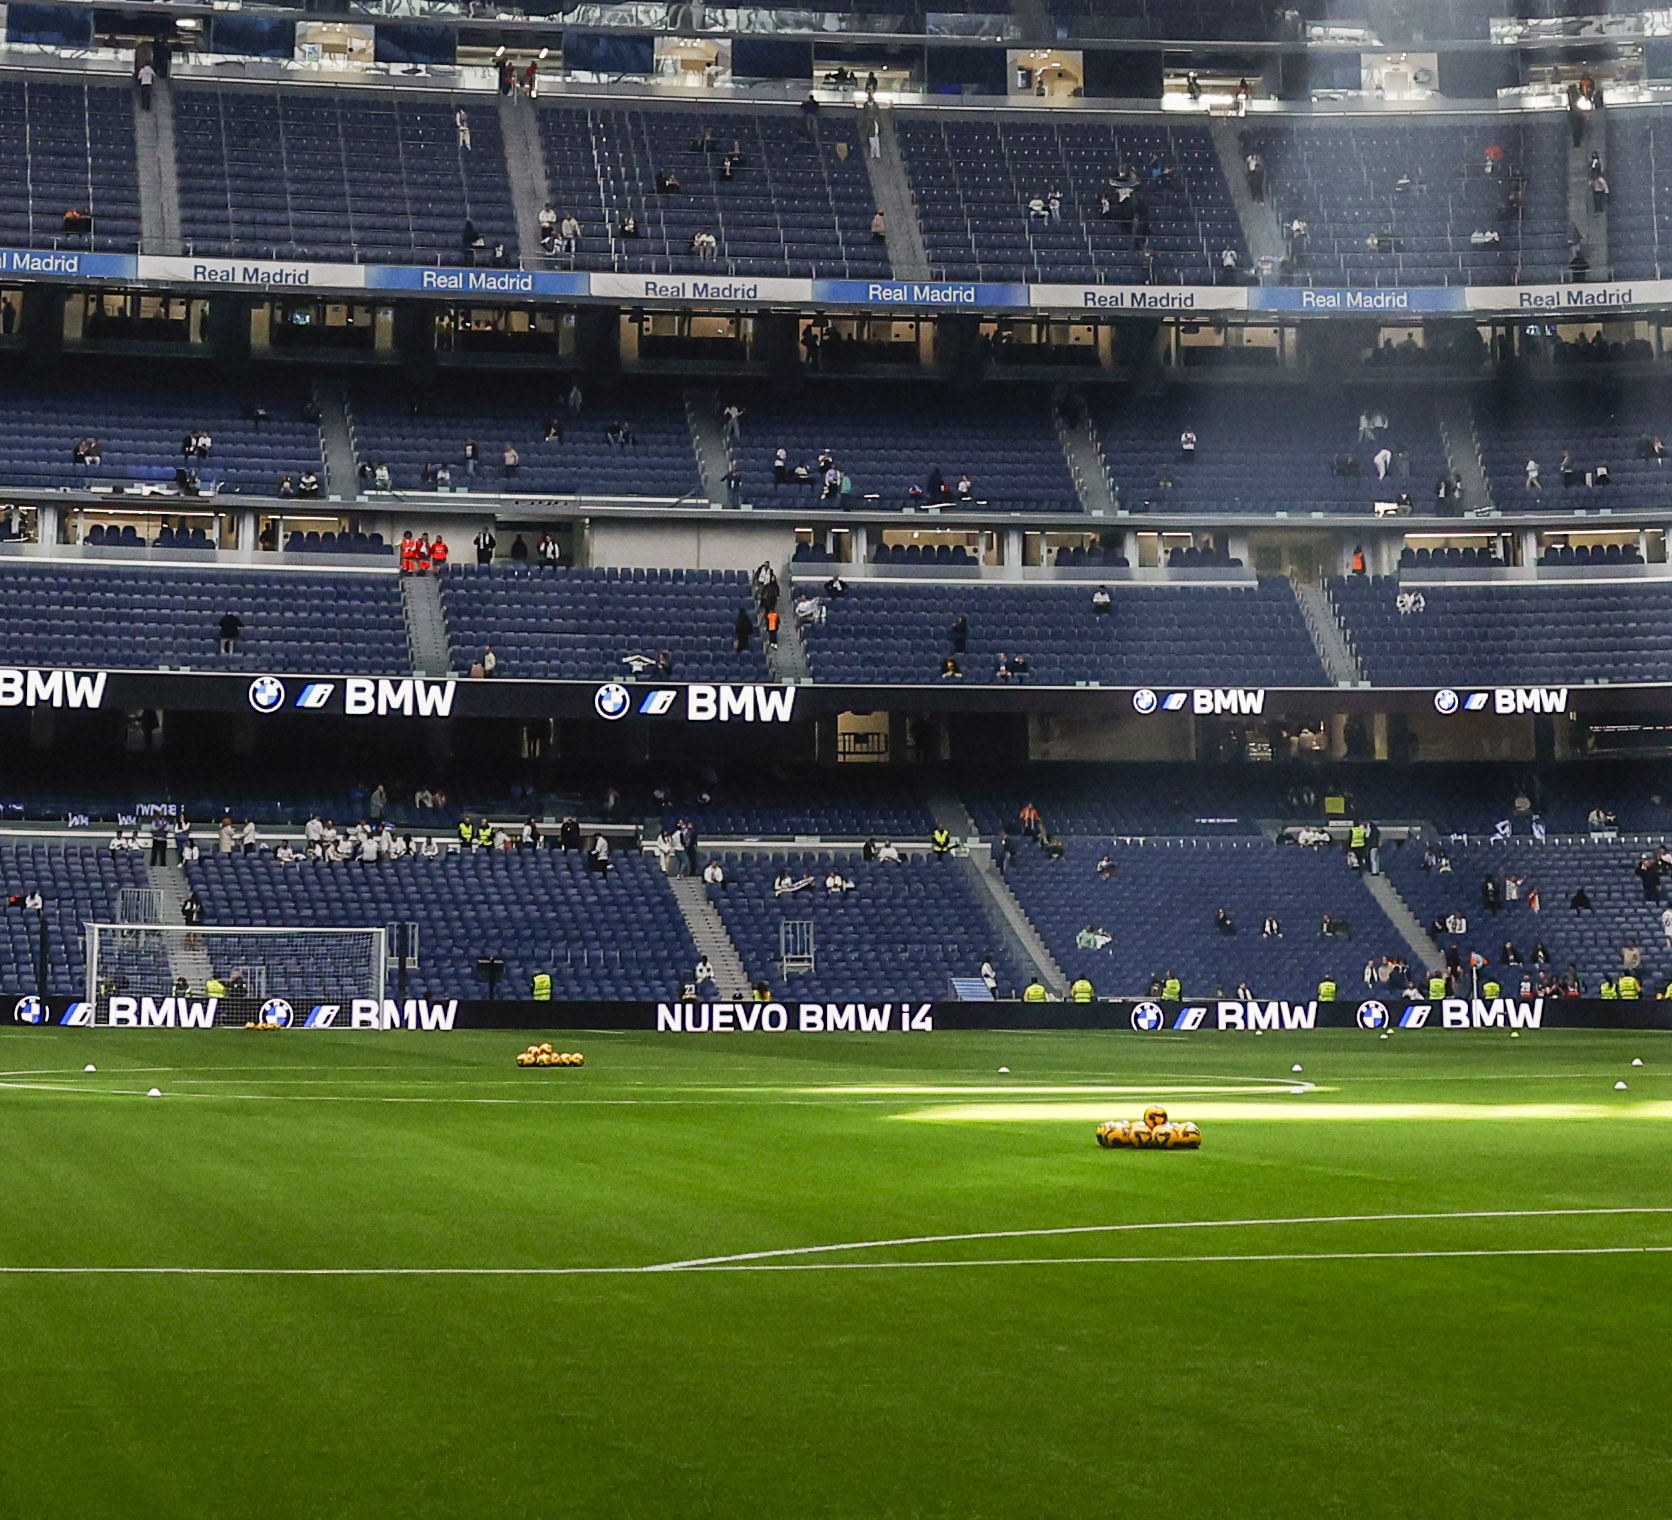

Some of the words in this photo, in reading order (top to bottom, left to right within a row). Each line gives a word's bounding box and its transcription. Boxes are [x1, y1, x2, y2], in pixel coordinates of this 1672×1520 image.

[12, 253, 78, 273] Madrid
[193, 264, 238, 284] Real
[242, 266, 309, 286] Madrid
[422, 270, 466, 289] Real
[471, 272, 532, 292] Madrid
[644, 281, 686, 299] Real
[692, 282, 758, 300] Madrid
[868, 284, 908, 302] Real
[913, 284, 975, 303] Madrid
[1083, 290, 1124, 308] Real
[1128, 290, 1194, 309] Madrid
[1302, 290, 1342, 308] Real
[1347, 290, 1409, 309] Madrid
[1519, 290, 1561, 308] Real
[1566, 288, 1632, 307] Madrid
[344, 678, 457, 717] BMW
[688, 685, 796, 722] BMW
[1193, 689, 1265, 715] BMW
[1495, 688, 1568, 715] BMW
[108, 997, 218, 1029] BMW
[350, 999, 459, 1031] BMW
[656, 1002, 788, 1033] NUEVO
[799, 1002, 893, 1032] BMW
[901, 1003, 933, 1032] i4
[1217, 1000, 1318, 1031] BMW
[1441, 998, 1544, 1030] BMW
